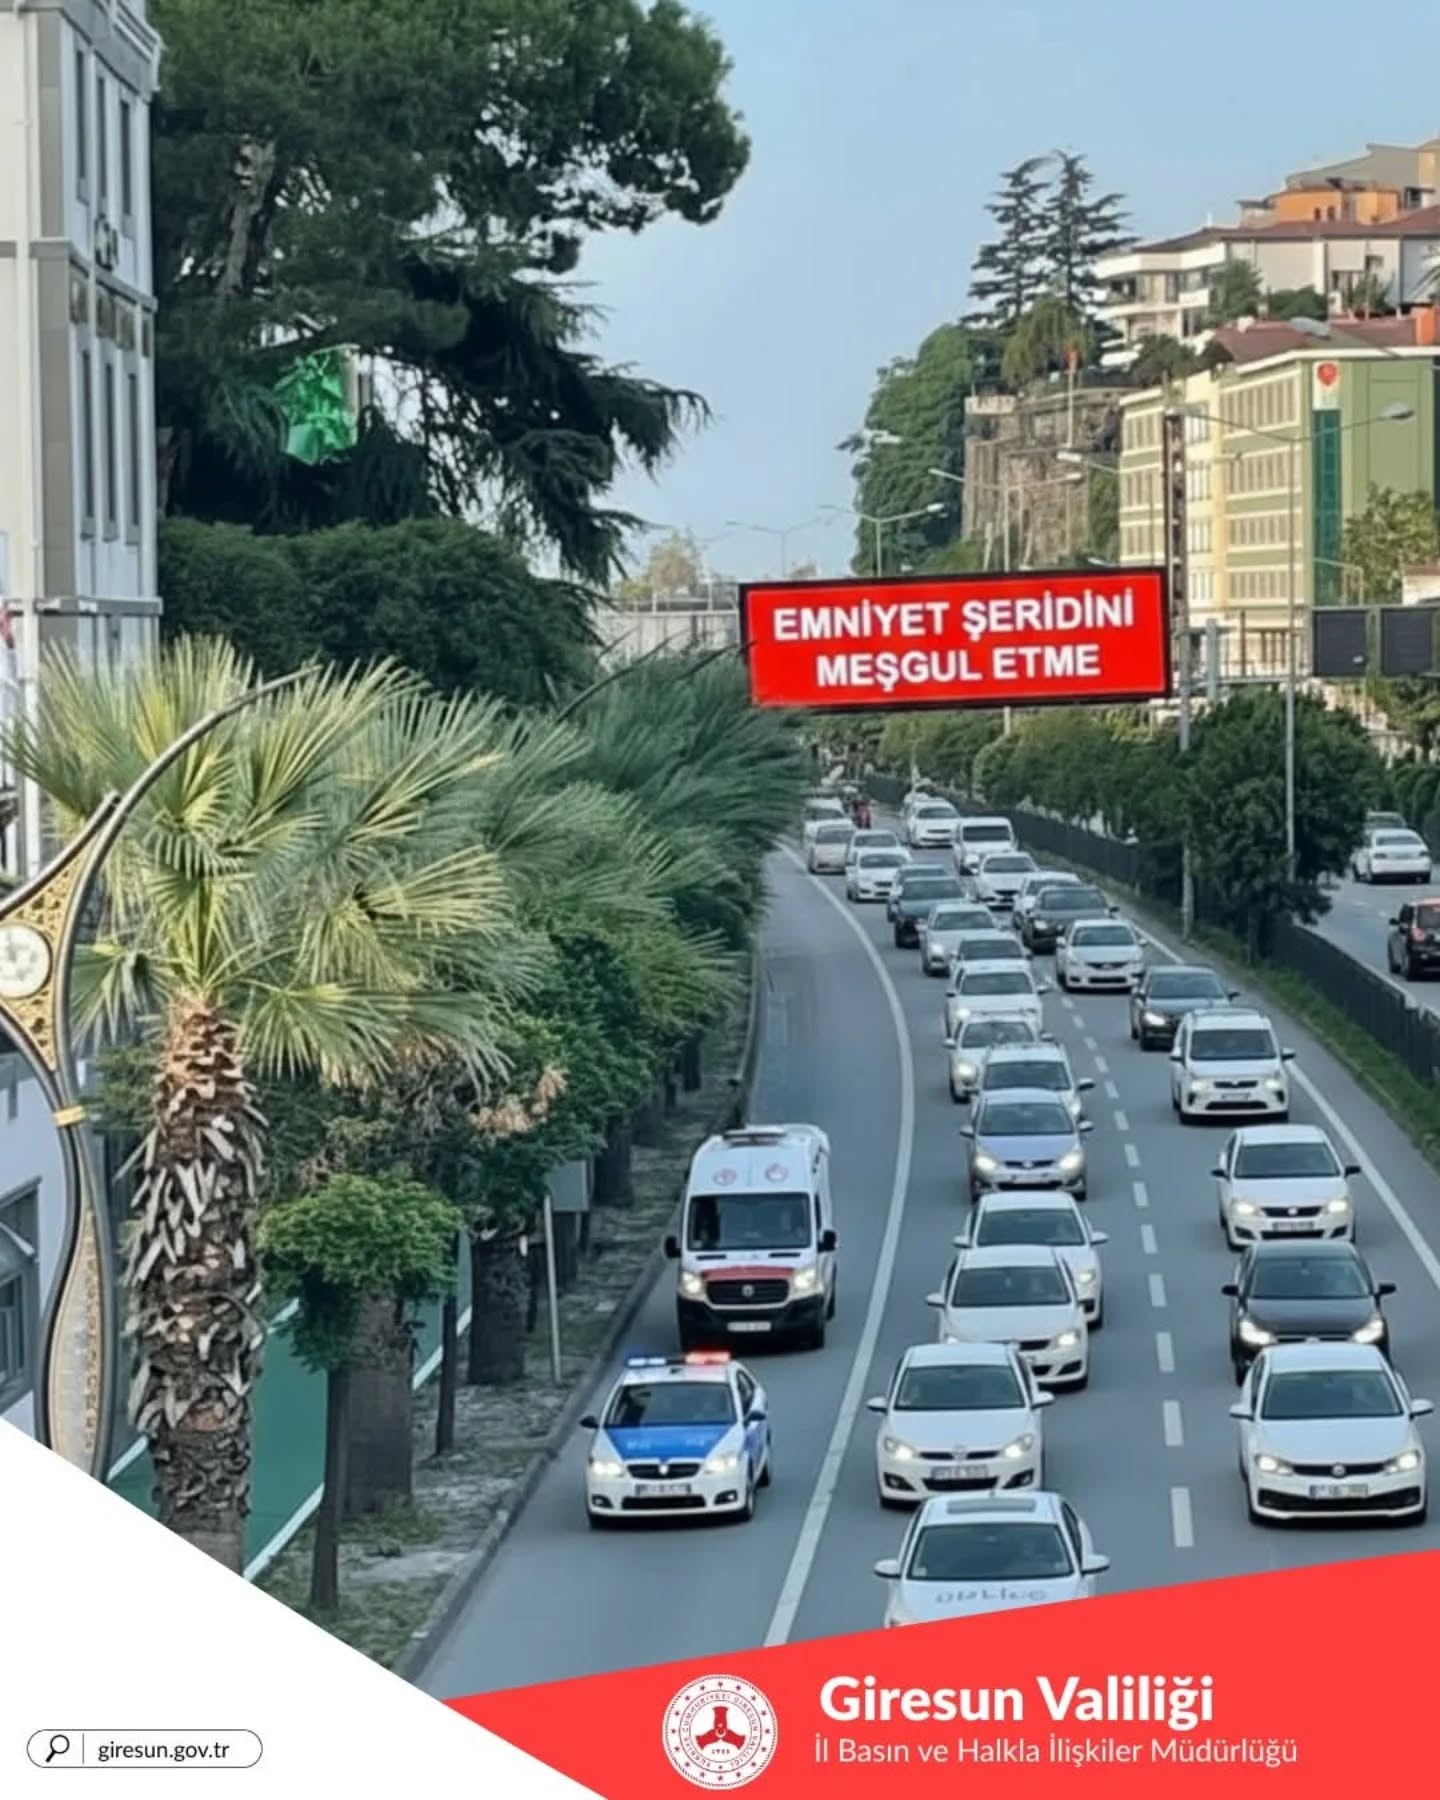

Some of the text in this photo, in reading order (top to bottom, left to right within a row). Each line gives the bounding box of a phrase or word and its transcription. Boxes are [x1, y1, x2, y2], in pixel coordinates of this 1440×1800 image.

[772, 587, 1134, 642] EMNİYET ŞERİDİNİ
[816, 644, 1101, 692] MEŞGUL ETME
